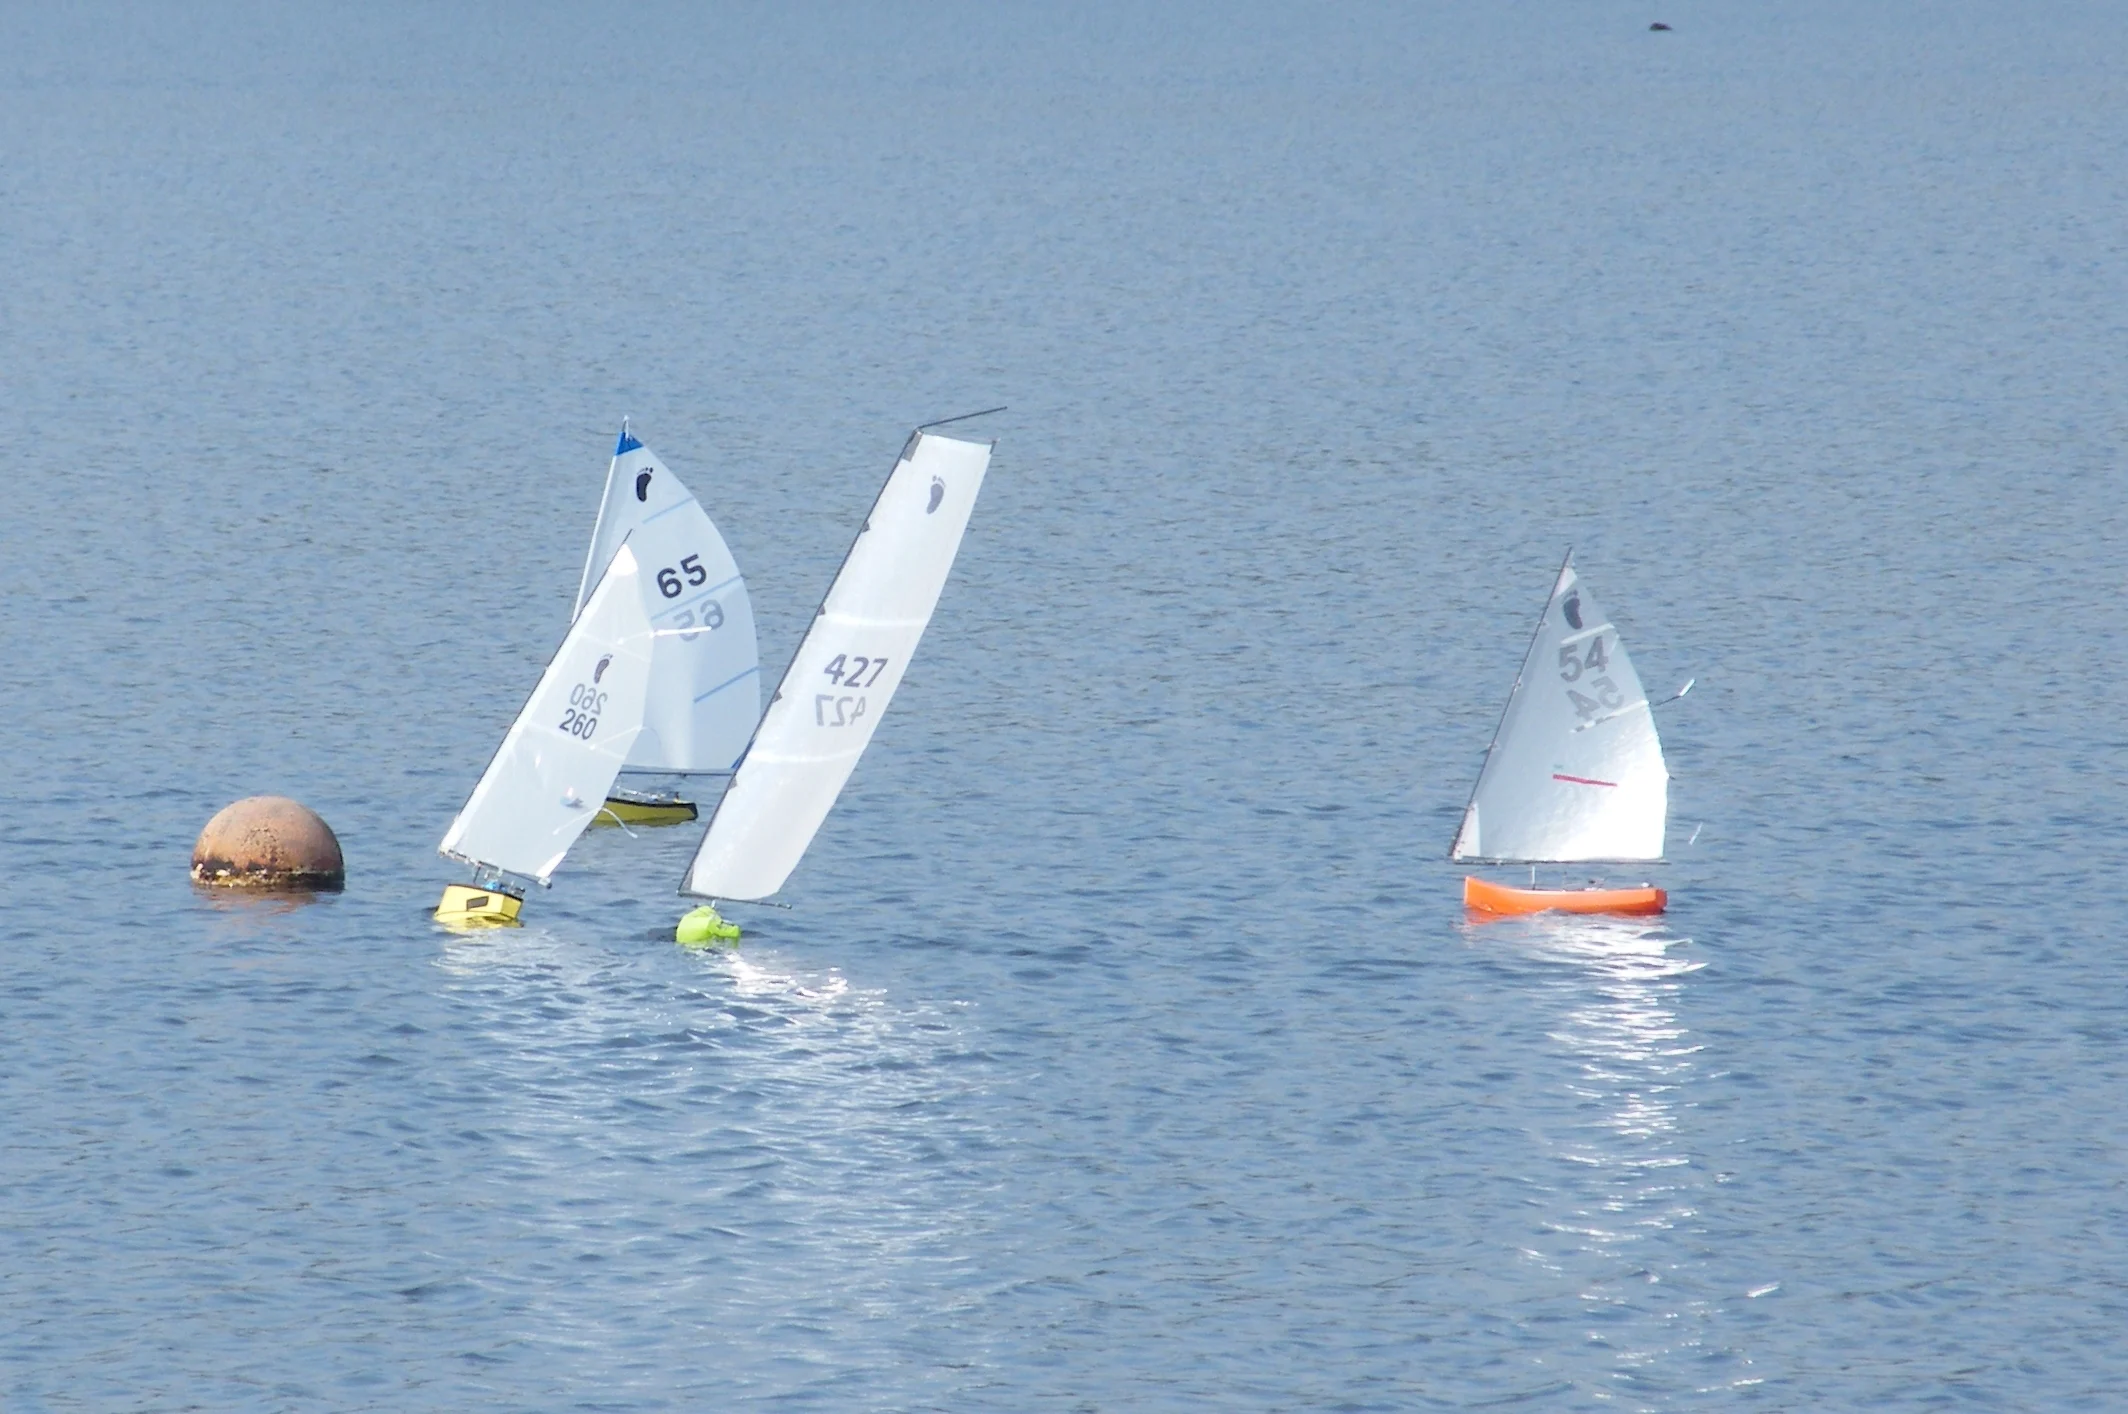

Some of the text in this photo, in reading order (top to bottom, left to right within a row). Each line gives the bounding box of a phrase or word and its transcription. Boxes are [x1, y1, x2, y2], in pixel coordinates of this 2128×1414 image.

[657, 554, 707, 599] 65
[824, 653, 888, 689] 427
[1558, 636, 1609, 682] 54
[559, 708, 597, 741] 260
